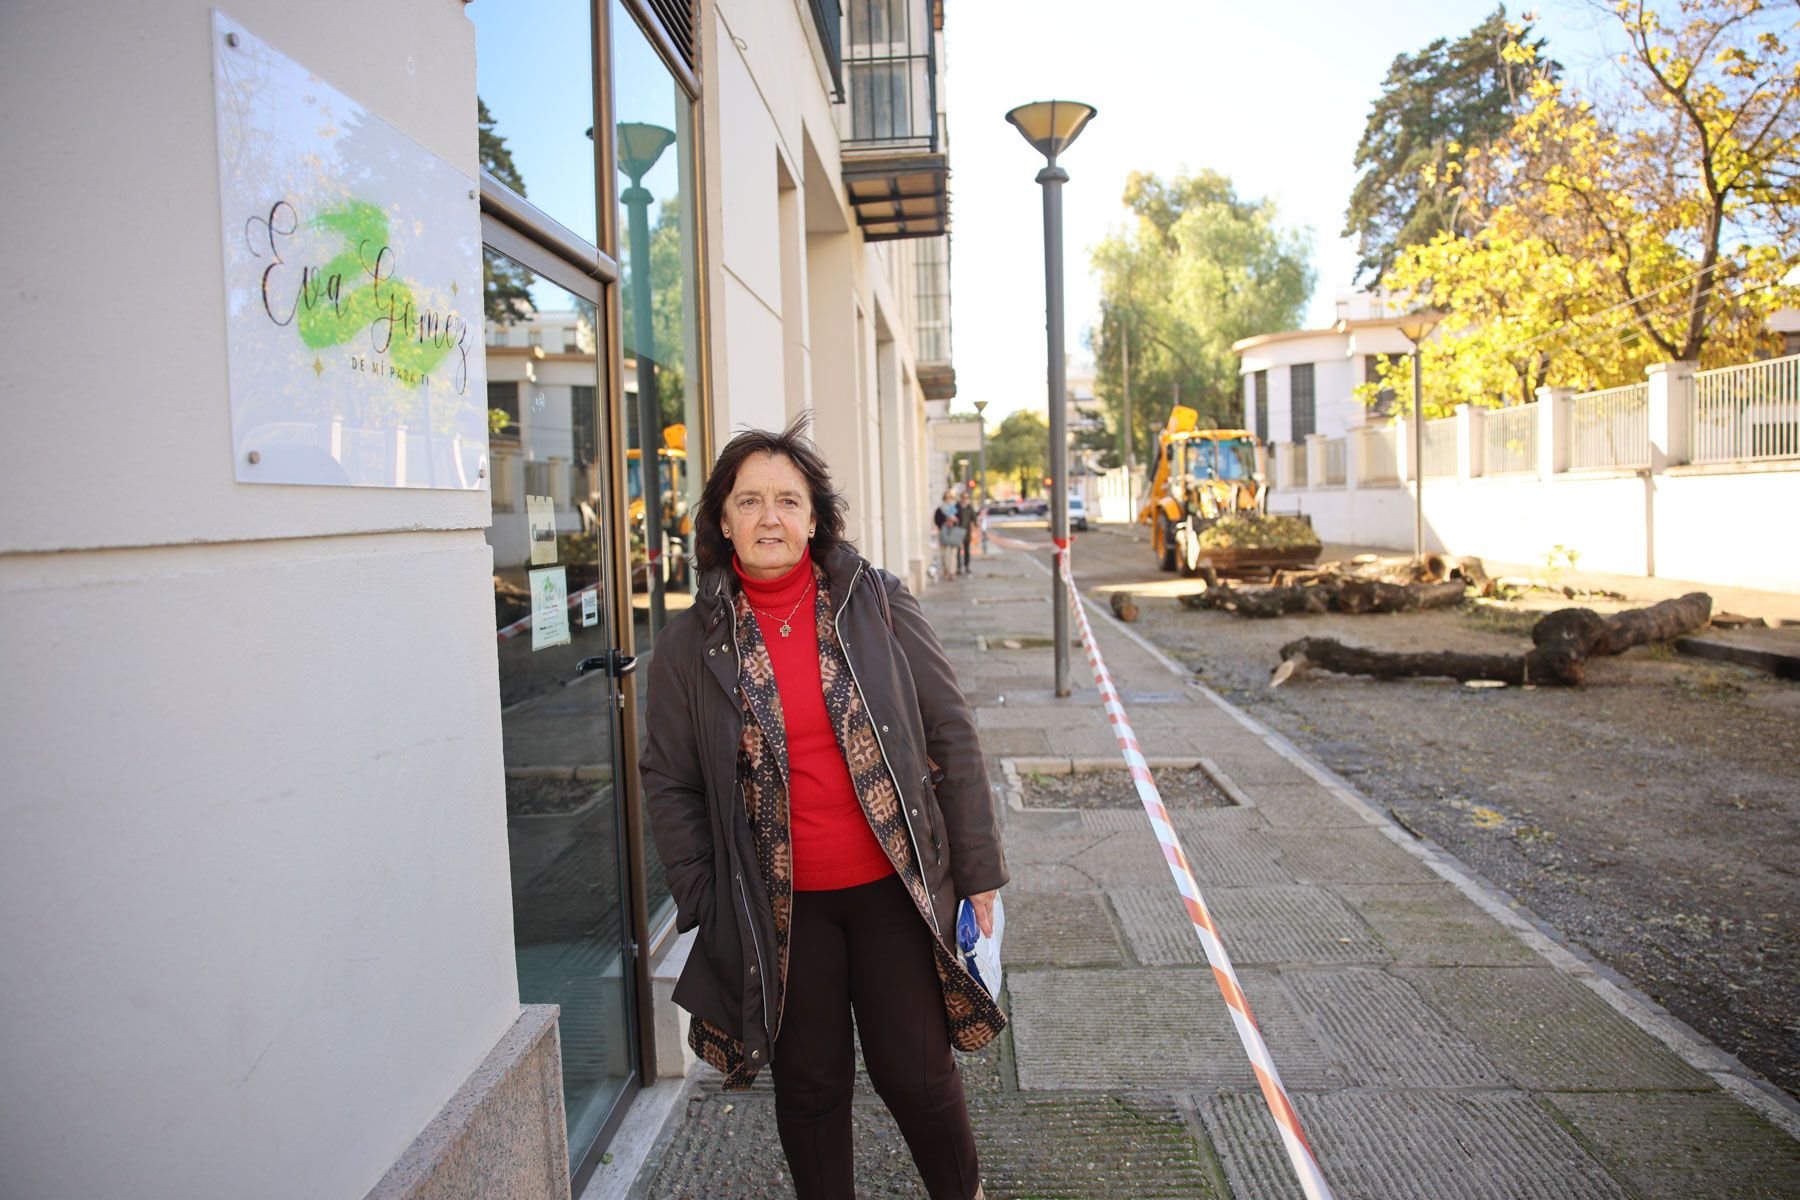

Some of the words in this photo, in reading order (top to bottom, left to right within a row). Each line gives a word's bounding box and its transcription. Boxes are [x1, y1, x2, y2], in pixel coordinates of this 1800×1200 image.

[246, 201, 351, 326] Eva
[351, 357, 365, 371] DE
[390, 367, 416, 384] PARA
[420, 374, 429, 386] TI
